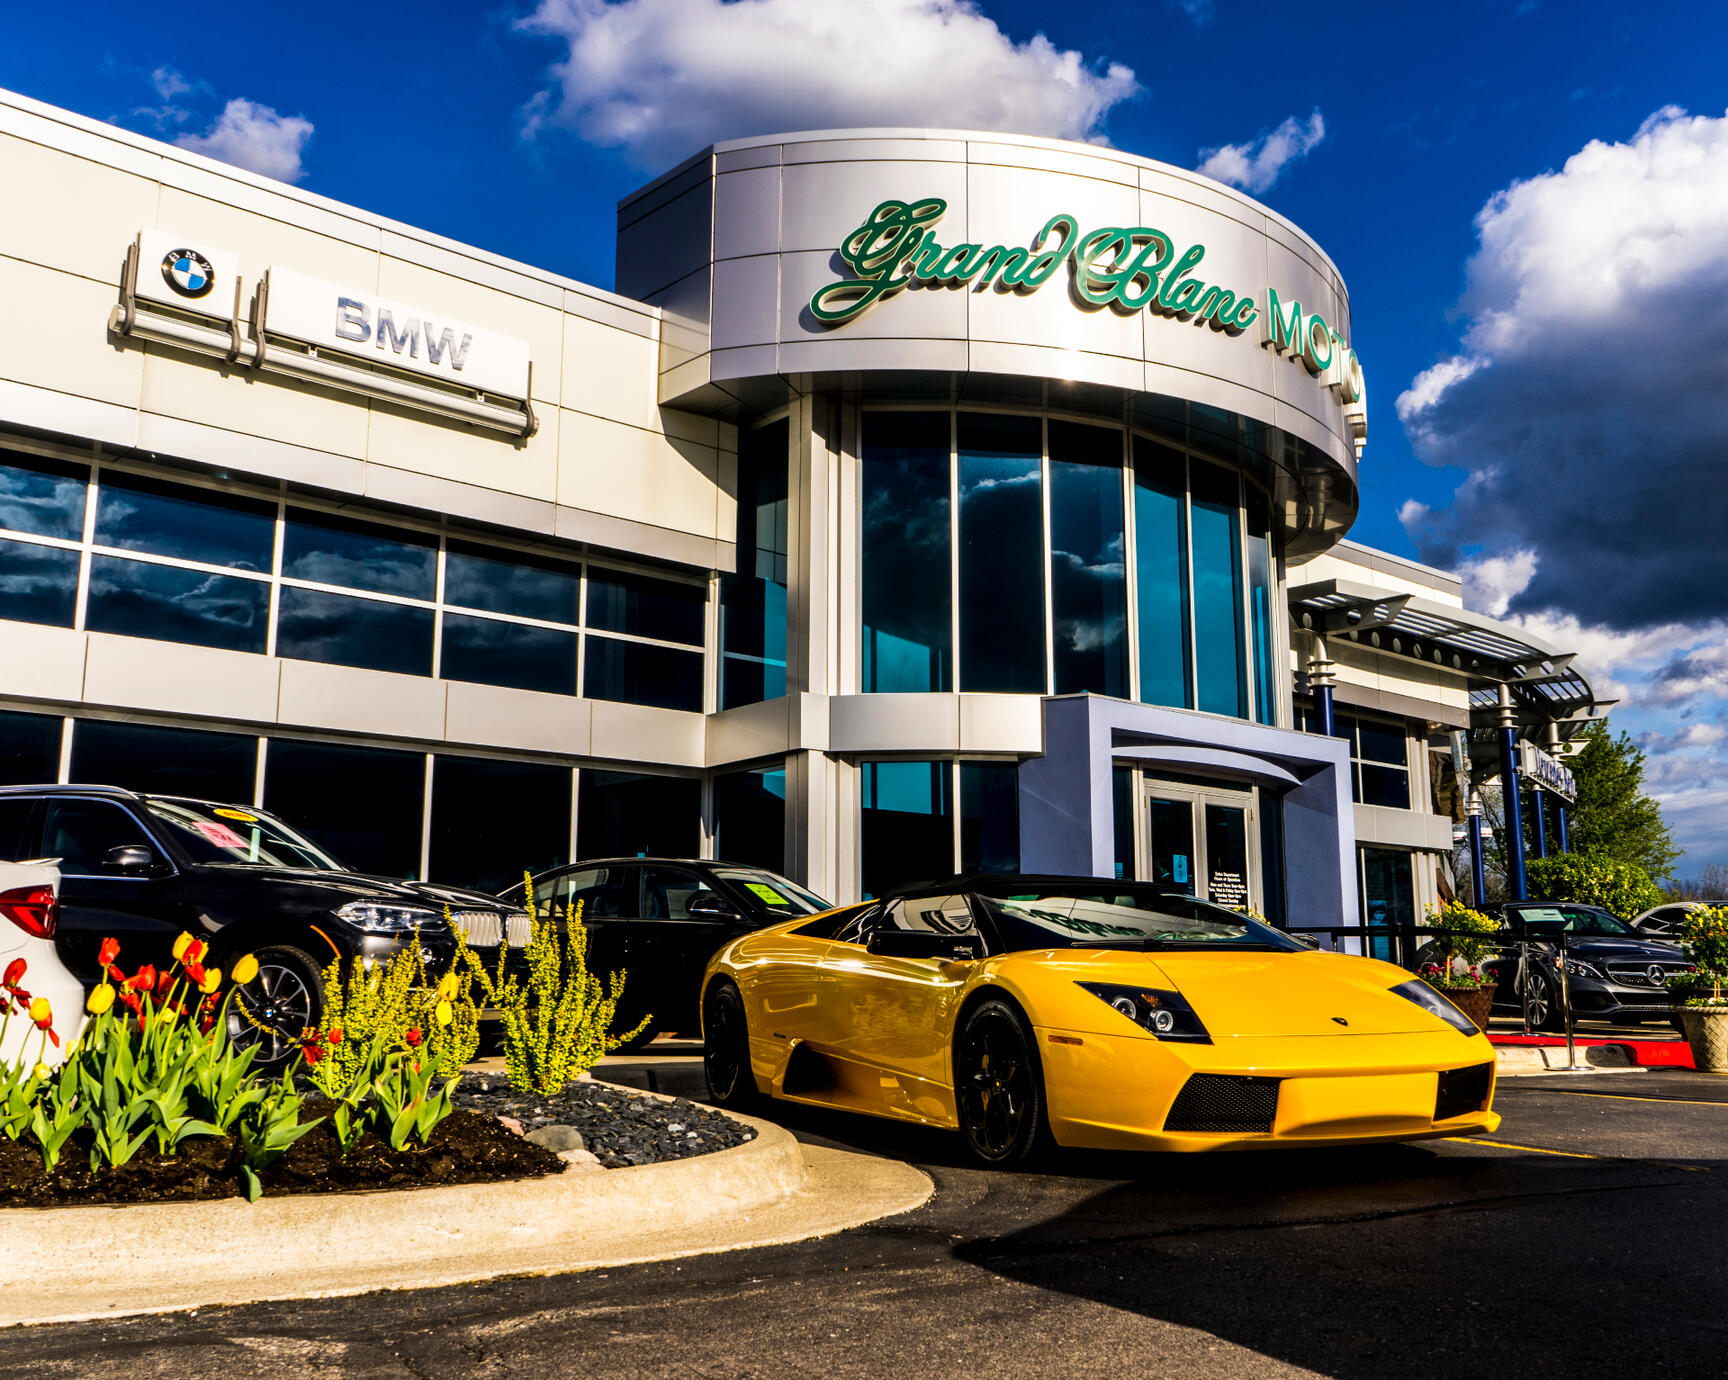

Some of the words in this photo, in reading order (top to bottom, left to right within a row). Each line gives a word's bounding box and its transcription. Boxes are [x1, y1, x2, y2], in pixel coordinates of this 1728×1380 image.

[810, 198, 1078, 320] Grand
[1076, 227, 1259, 330] Blanc
[335, 296, 473, 372] BMW
